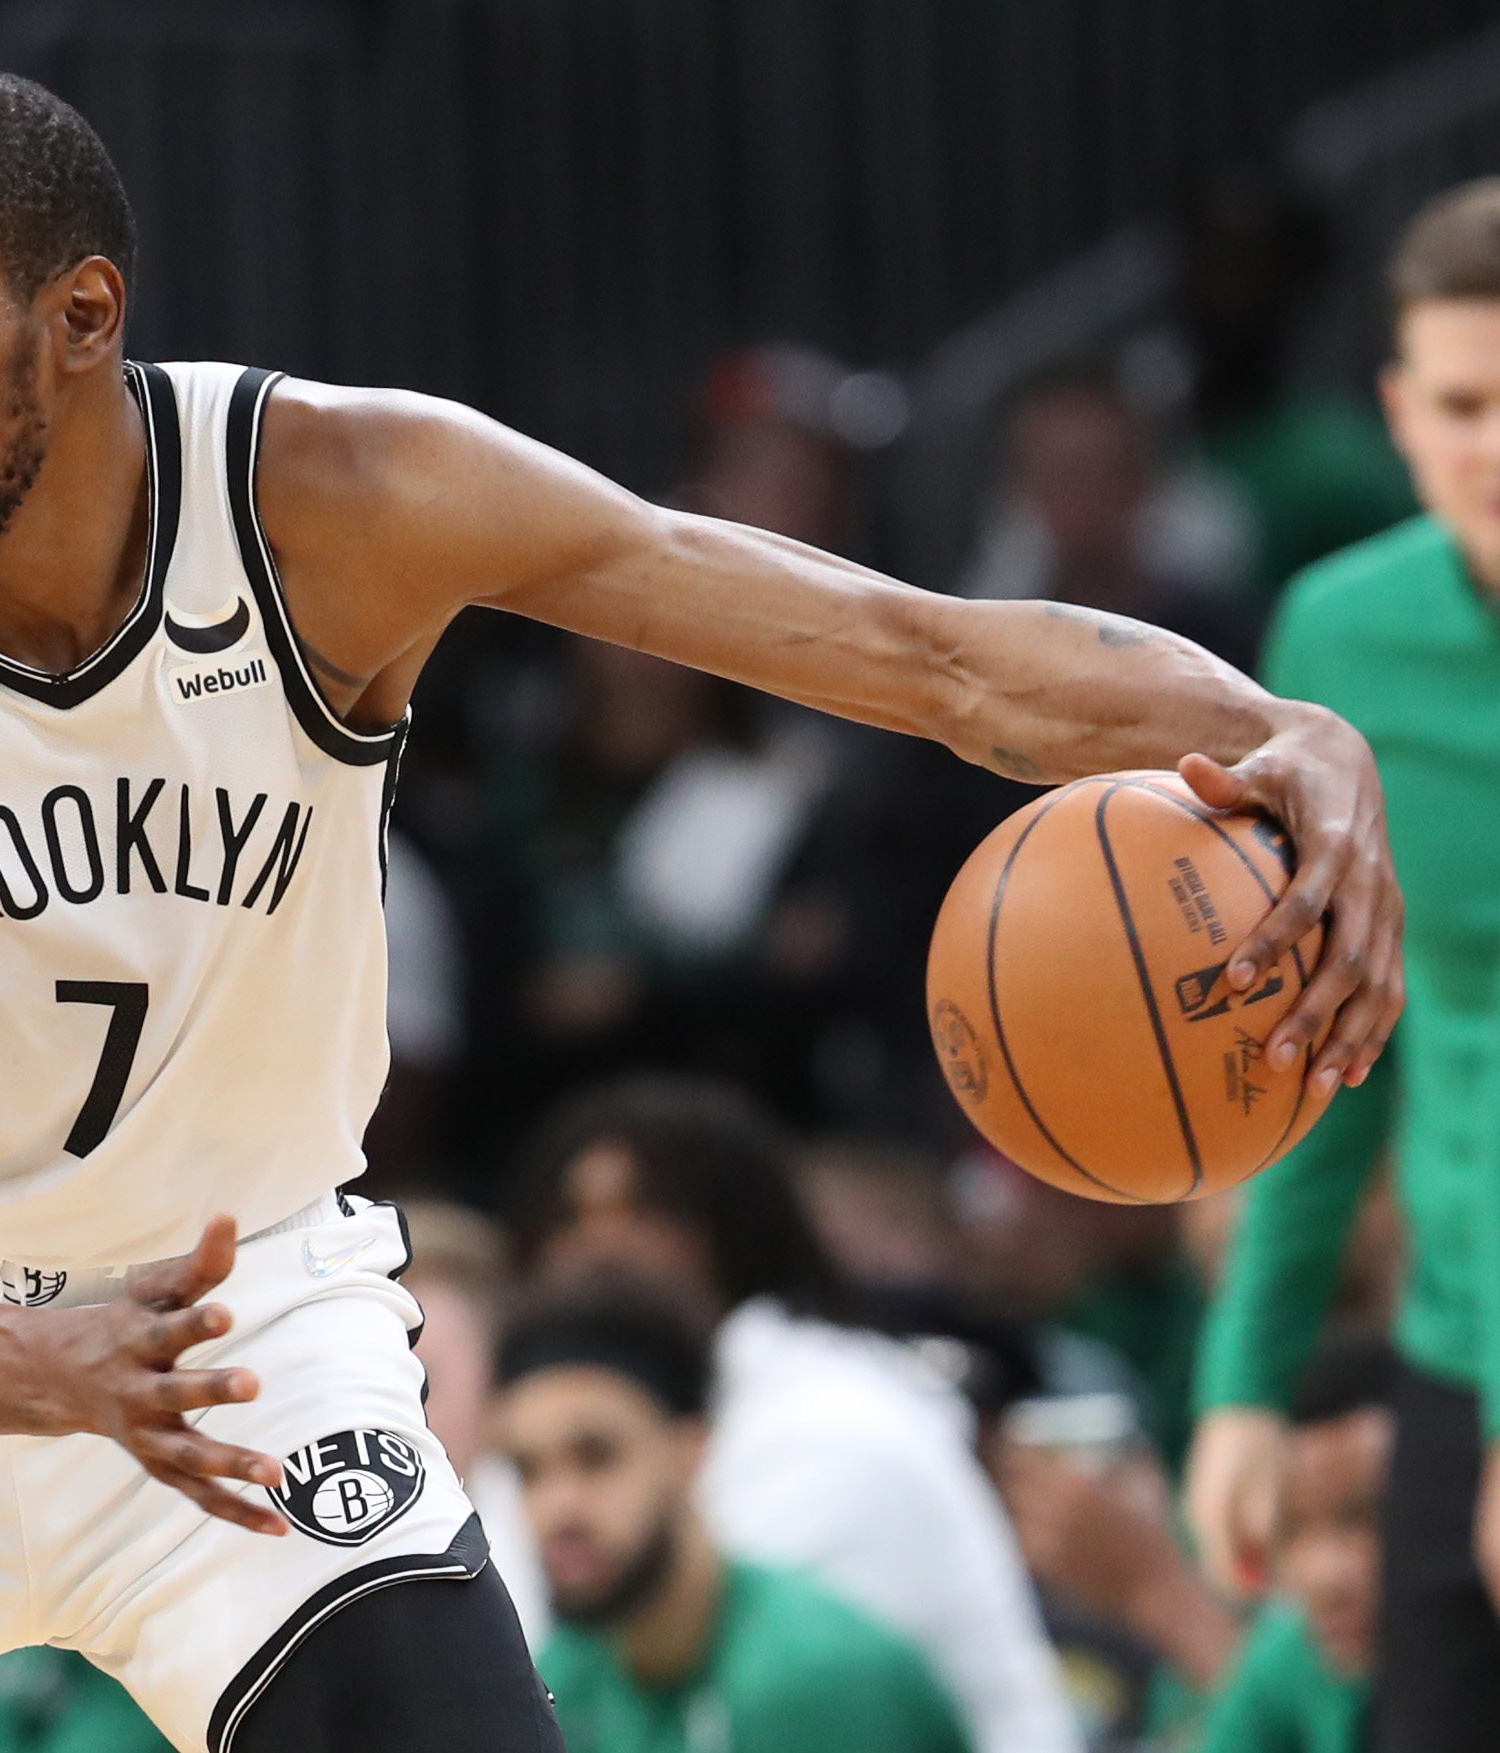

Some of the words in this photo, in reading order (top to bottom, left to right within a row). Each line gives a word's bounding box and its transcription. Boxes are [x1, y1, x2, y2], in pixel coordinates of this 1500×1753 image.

[177, 659, 268, 701] Webull
[55, 980, 149, 1160] 7
[277, 1429, 416, 1501] NETS
[338, 1478, 368, 1525] B
